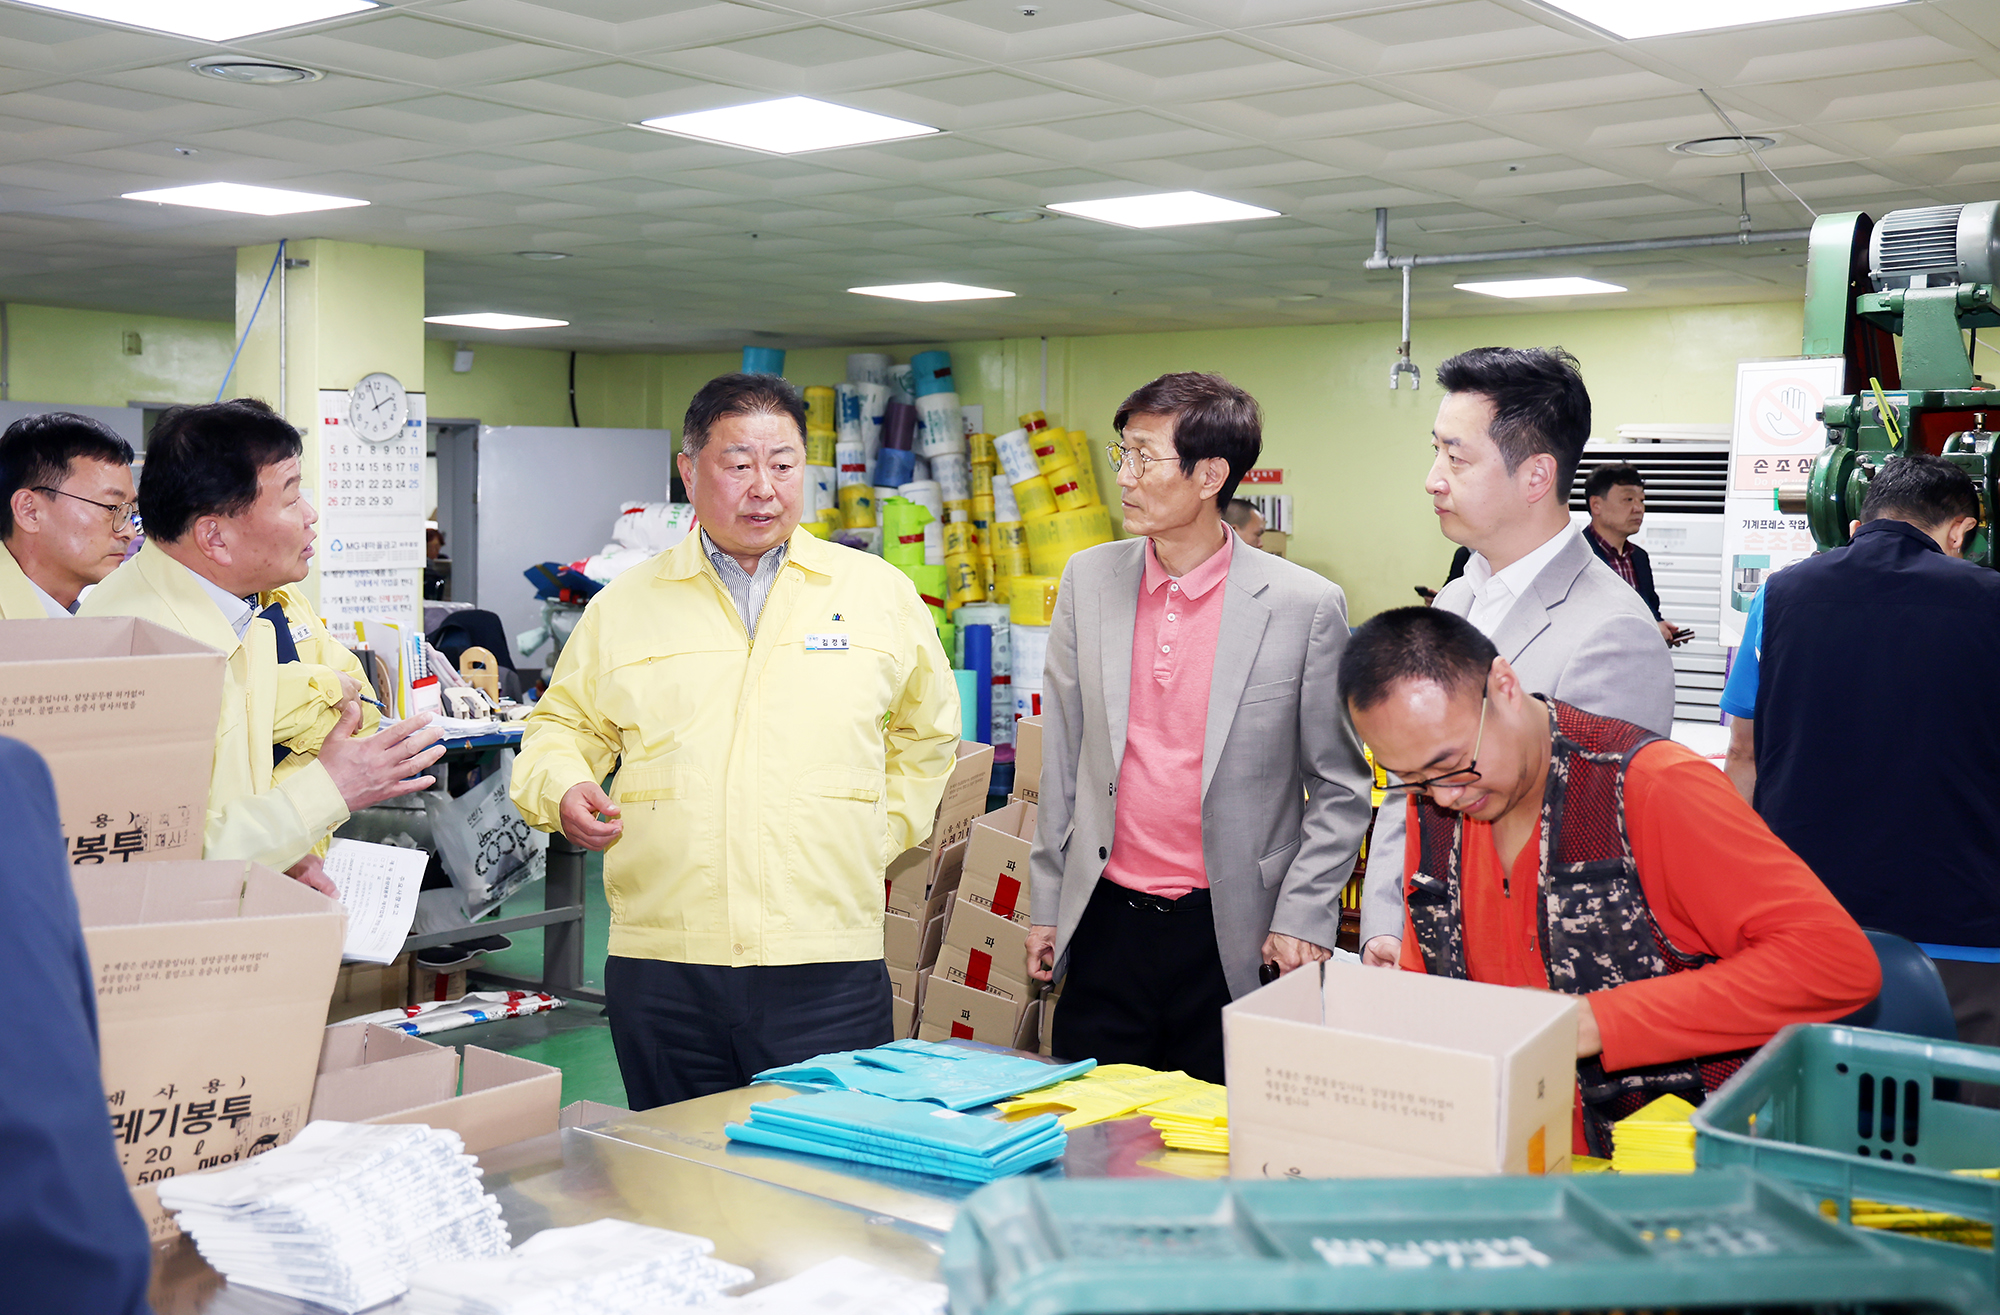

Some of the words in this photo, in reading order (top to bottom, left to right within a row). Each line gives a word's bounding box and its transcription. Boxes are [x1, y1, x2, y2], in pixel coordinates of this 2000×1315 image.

[330, 445, 336, 454] 5
[343, 445, 348, 454] 6
[357, 445, 361, 454] 7
[370, 445, 376, 454] 8
[384, 445, 389, 454] 9
[396, 445, 406, 454] 10
[410, 445, 418, 454] 11
[329, 462, 338, 471] 12
[342, 462, 351, 471] 13
[356, 462, 364, 471] 14
[370, 462, 378, 471] 15
[383, 462, 392, 471] 16
[396, 462, 405, 471] 17
[410, 462, 419, 471] 18
[1754, 458, 1813, 474] 손조심
[329, 480, 338, 489] 19
[341, 480, 352, 489] 20
[355, 480, 364, 489] 21
[369, 480, 379, 489] 22
[382, 480, 392, 489] 23
[396, 480, 405, 489] 24
[409, 480, 419, 489] 25
[1754, 478, 1768, 486] Do
[328, 497, 338, 506] 26
[342, 497, 351, 506] 27
[355, 497, 365, 506] 28
[369, 497, 379, 506] 29
[382, 497, 393, 506] 30
[1742, 520, 1785, 530] 기계프레스
[1744, 532, 1811, 552] 손조심
[116, 690, 145, 699] 허가없이
[65, 826, 144, 865] 봉투
[1006, 860, 1016, 872] 파
[984, 936, 994, 948] 파
[961, 1009, 970, 1020] 파
[144, 1146, 172, 1164] 20
[137, 1167, 176, 1186] 500
